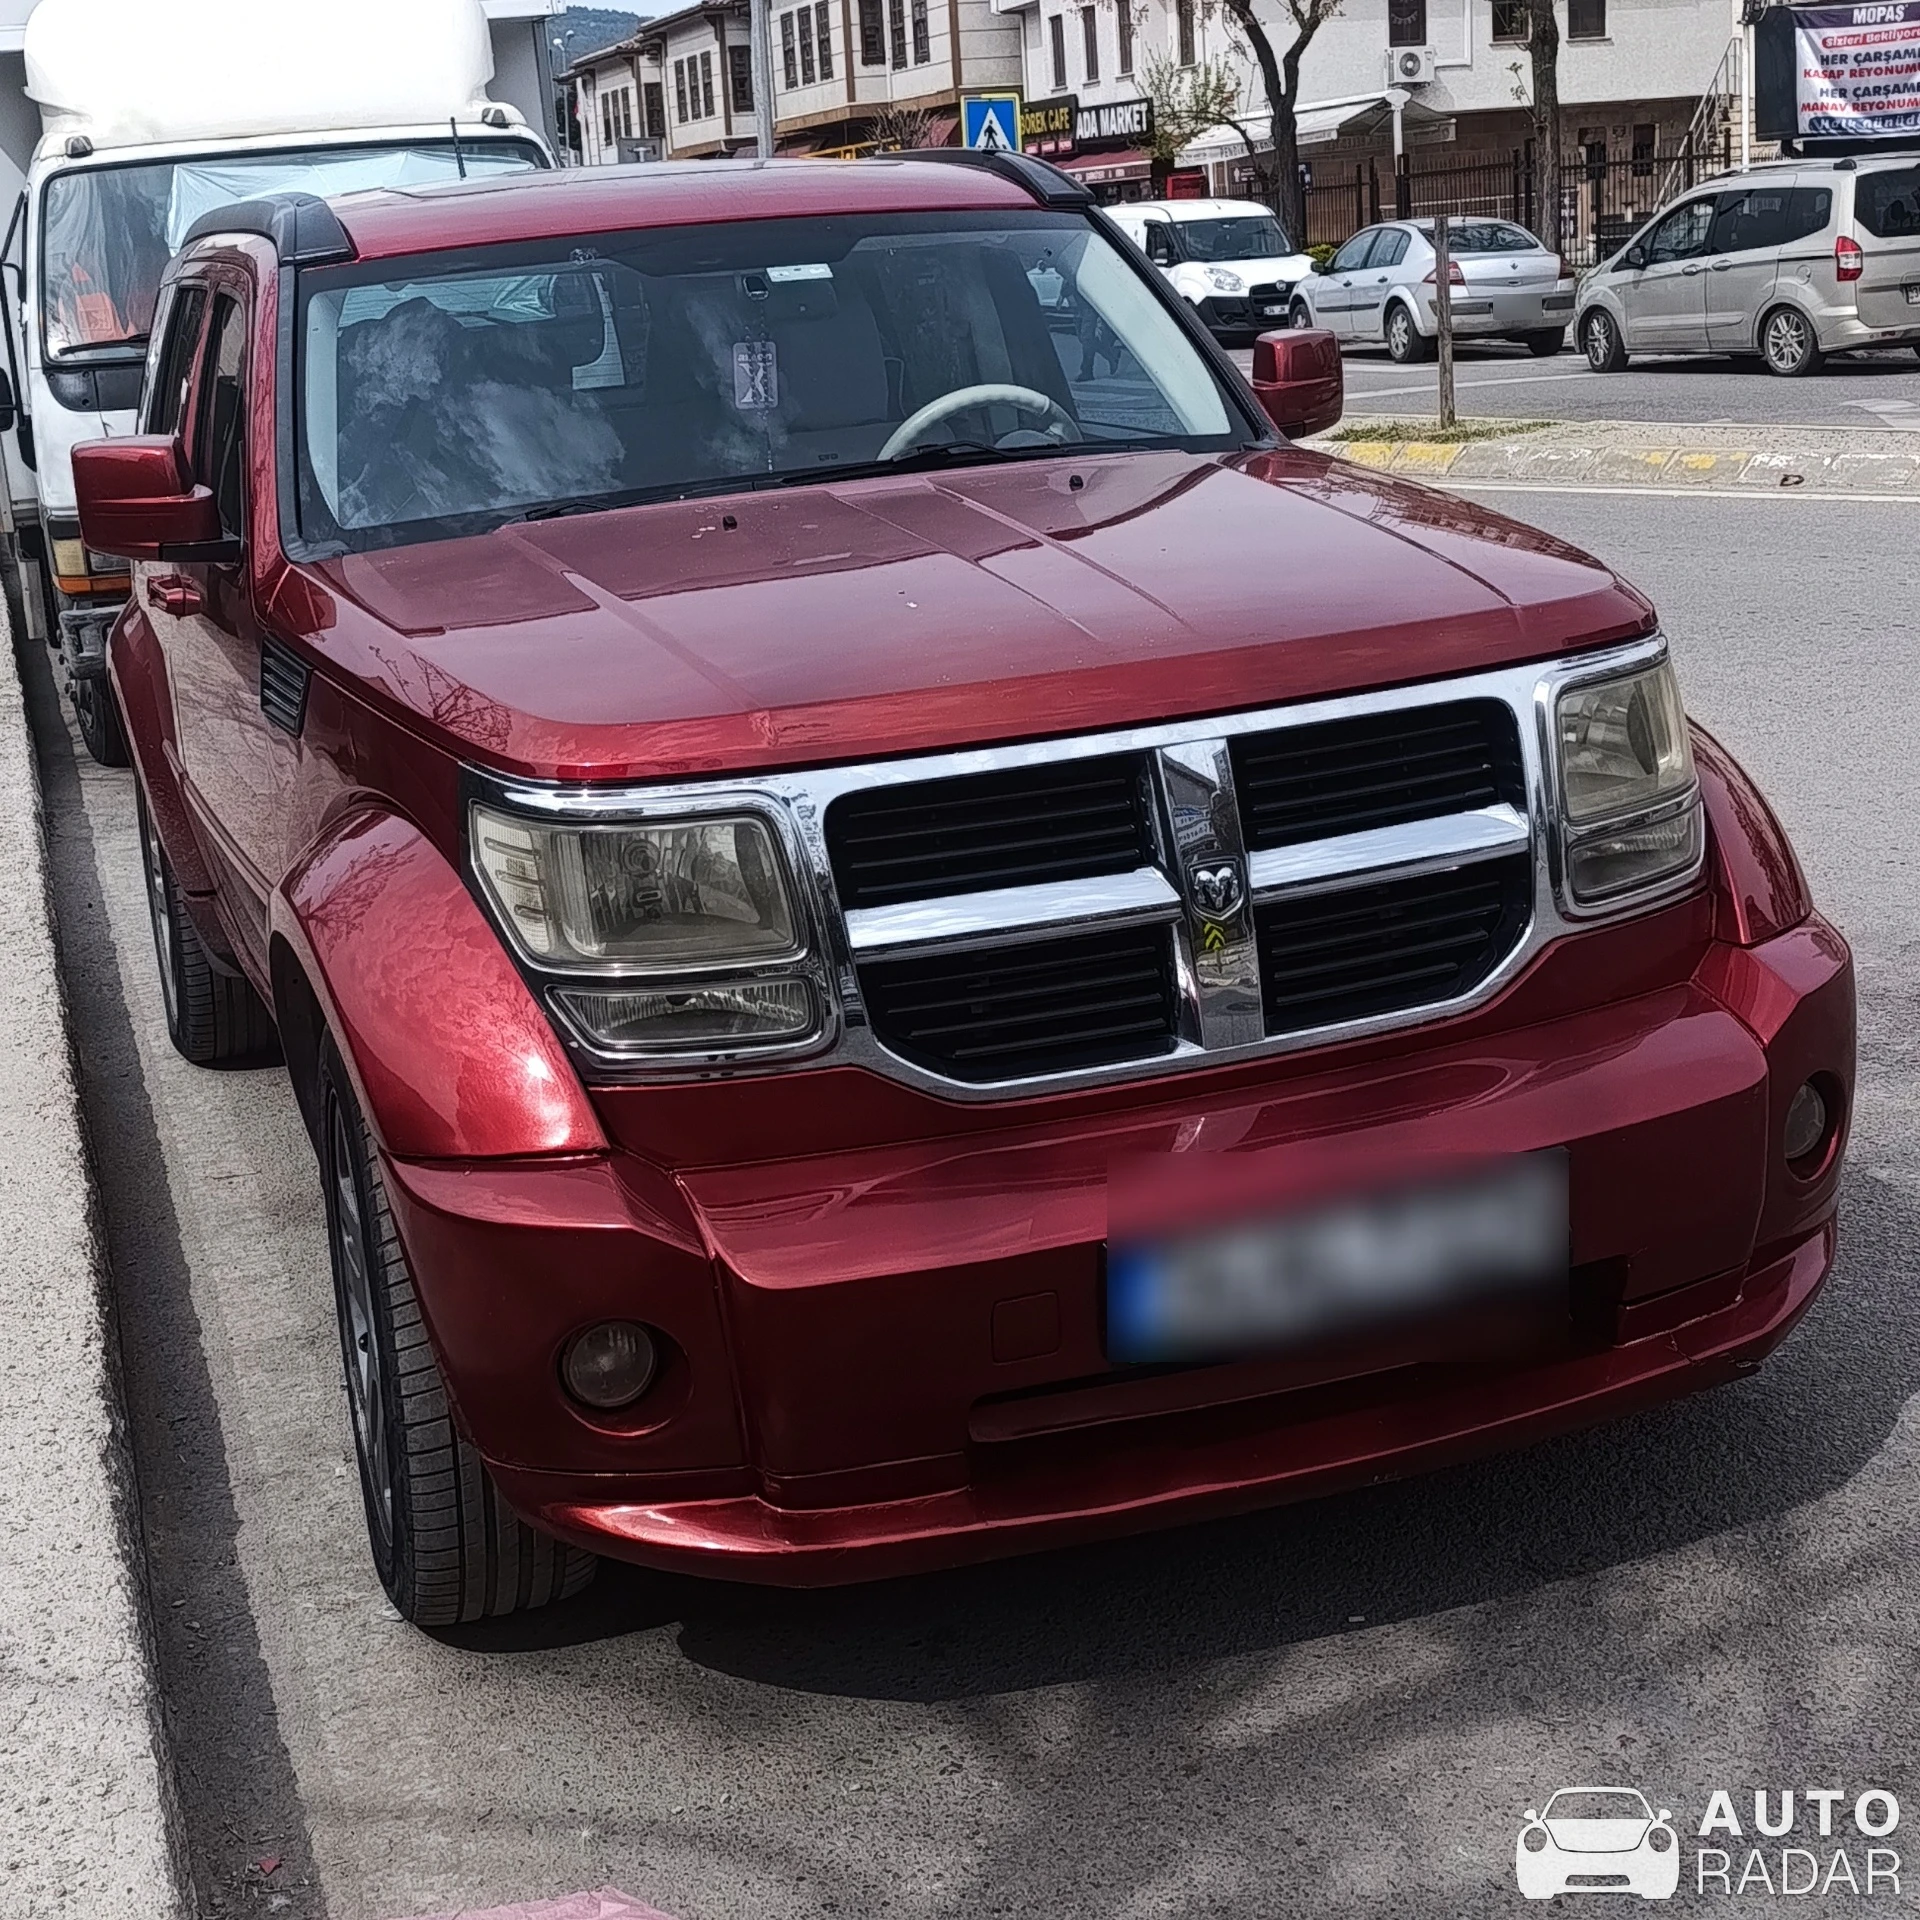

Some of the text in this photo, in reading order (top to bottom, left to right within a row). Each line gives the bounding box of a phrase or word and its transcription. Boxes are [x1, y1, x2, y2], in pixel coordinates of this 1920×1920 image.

[1821, 54, 1848, 65] HER
[1804, 69, 1844, 79] KASAP
[1820, 87, 1847, 98] HER
[1801, 98, 1920, 112] MANAV REYONUM
[1049, 106, 1070, 131] CAFE
[1076, 103, 1148, 139] ADA MARKET
